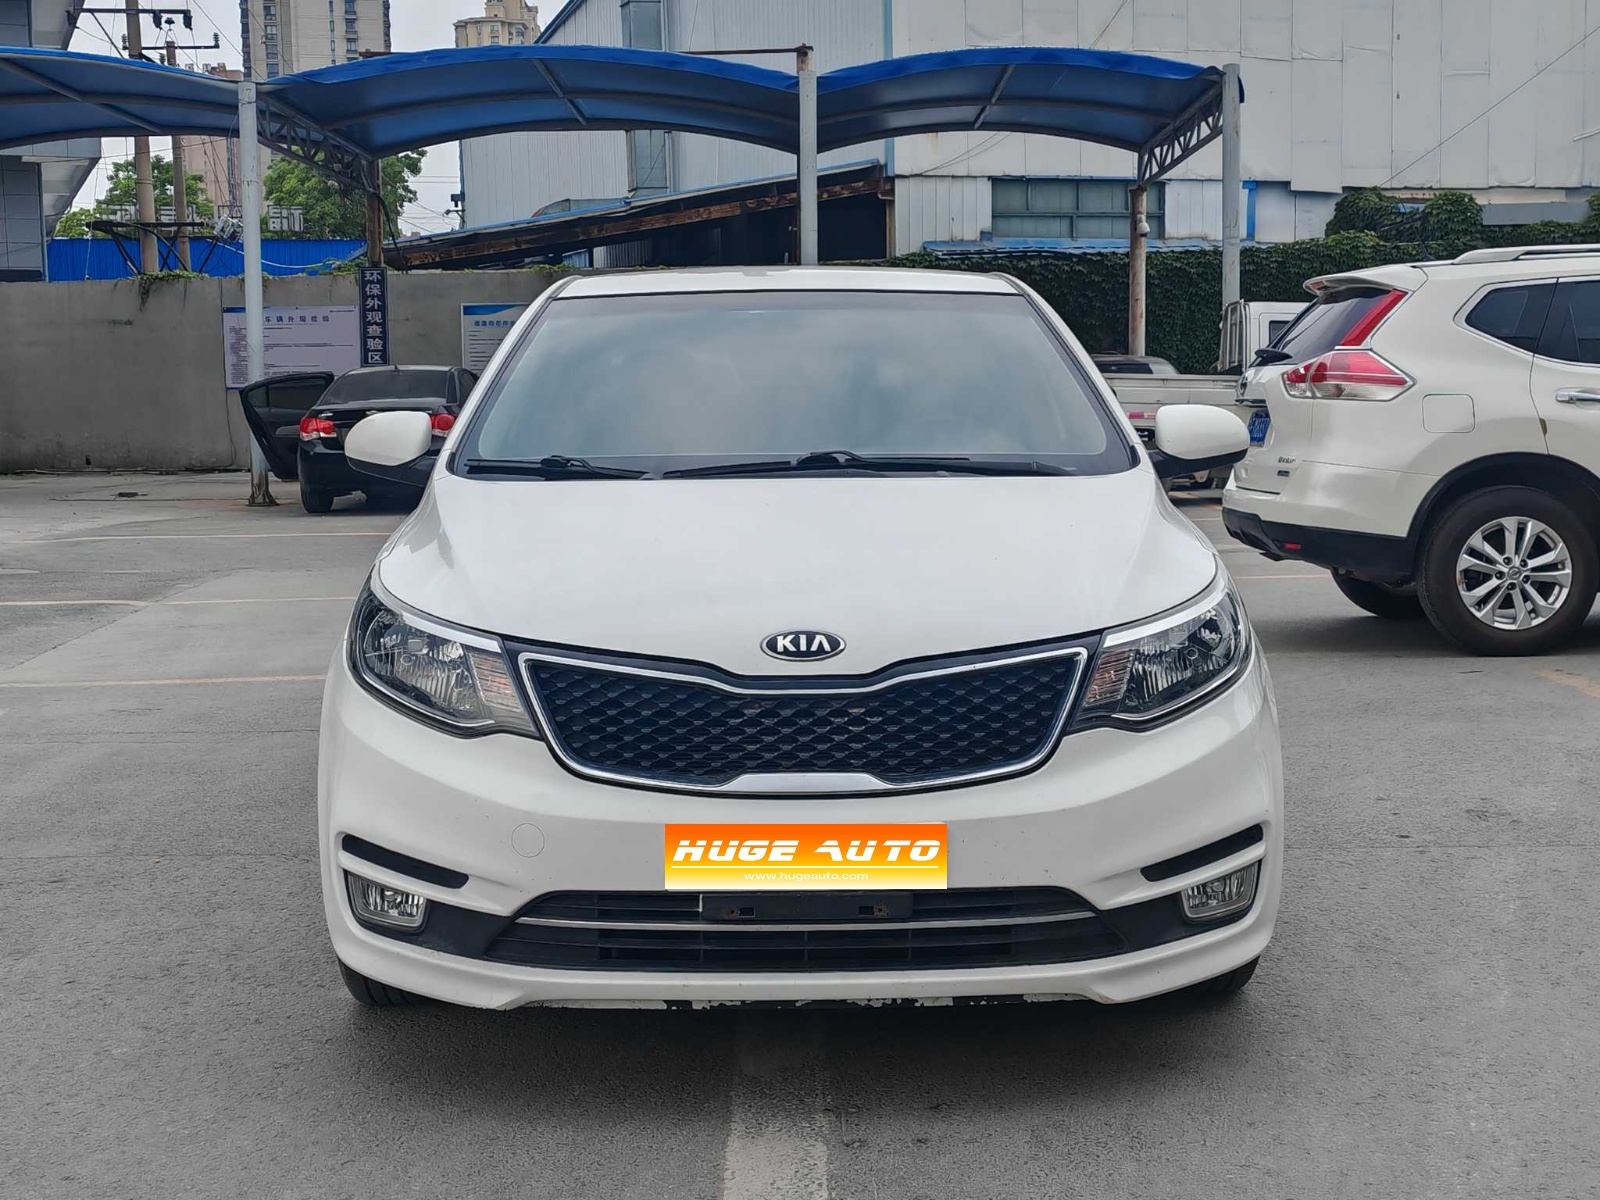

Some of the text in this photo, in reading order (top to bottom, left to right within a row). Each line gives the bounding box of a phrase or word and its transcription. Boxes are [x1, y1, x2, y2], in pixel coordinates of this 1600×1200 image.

[364, 270, 384, 364] 环保外观查验区
[776, 634, 832, 652] KIA
